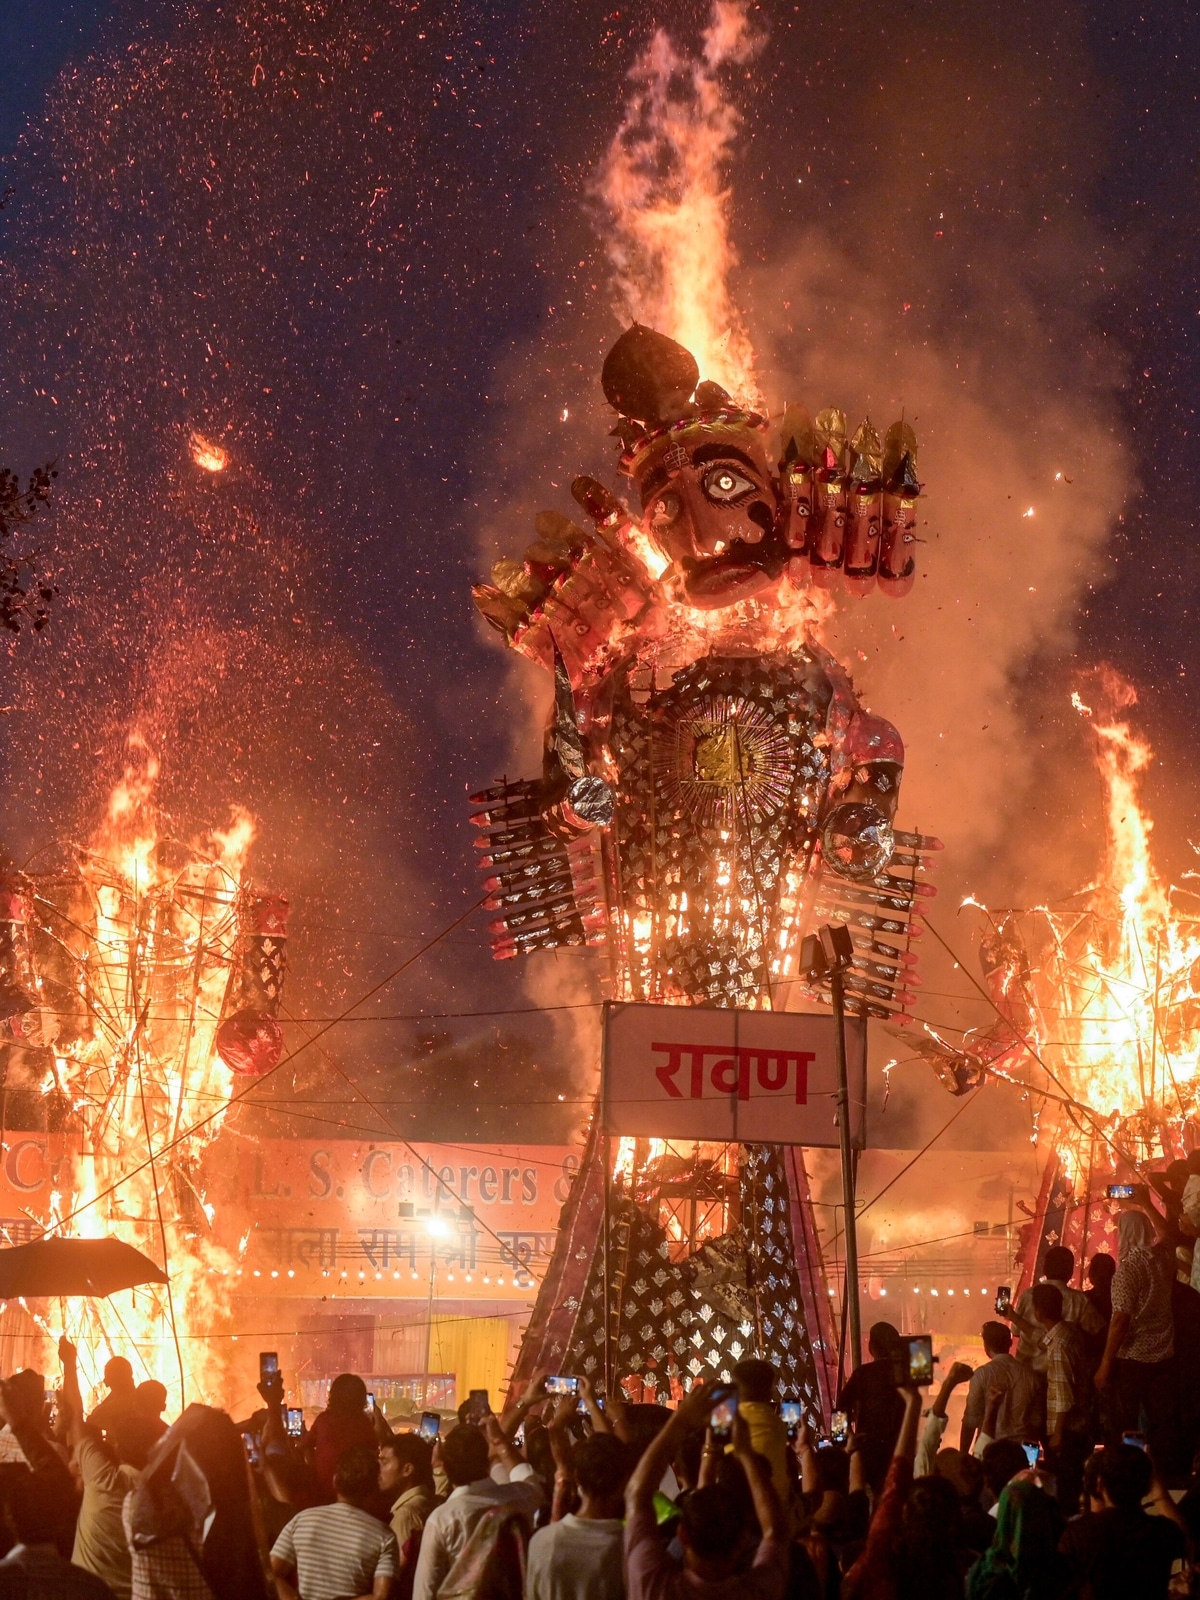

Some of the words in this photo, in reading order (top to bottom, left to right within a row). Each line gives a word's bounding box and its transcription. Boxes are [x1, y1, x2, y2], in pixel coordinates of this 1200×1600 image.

[651, 1042, 816, 1105] रावण
[252, 1151, 291, 1199] L.
[309, 1149, 344, 1199] S.
[362, 1150, 537, 1204] Caterers
[357, 1228, 419, 1270] राम
